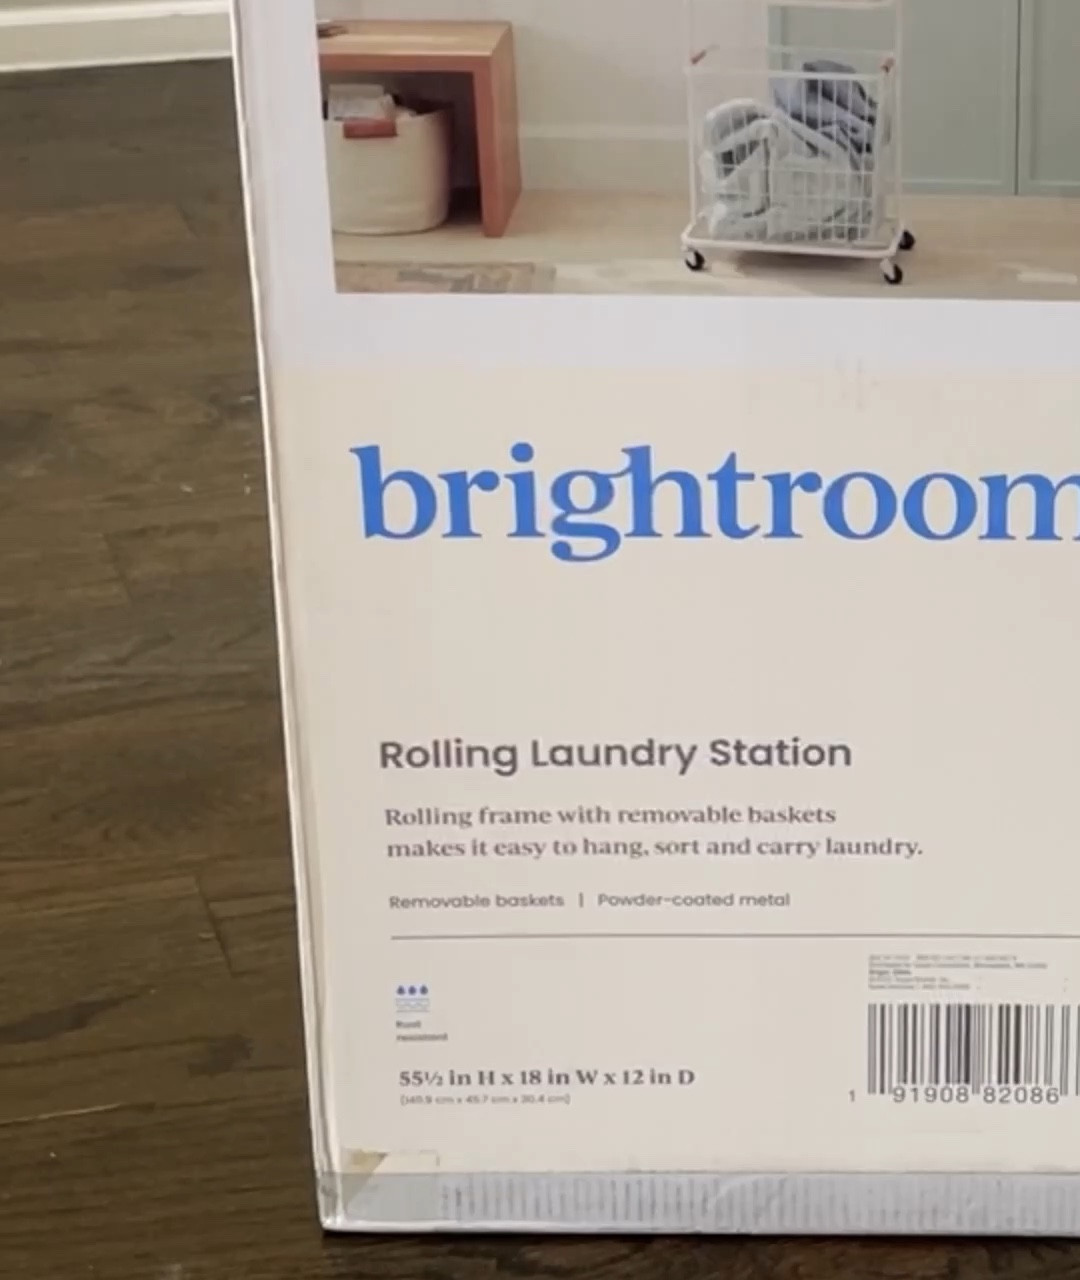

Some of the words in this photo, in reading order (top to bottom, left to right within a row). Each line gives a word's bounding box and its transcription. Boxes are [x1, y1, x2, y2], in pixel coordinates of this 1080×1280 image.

[379, 736, 519, 778] Rolling
[530, 737, 699, 777] Laundry
[708, 735, 852, 768] Station
[384, 806, 473, 830] Rolling
[478, 805, 553, 825] frame
[556, 805, 611, 825] with
[617, 805, 742, 824] removable
[747, 805, 837, 824] baskets
[387, 839, 466, 858] makes
[471, 838, 488, 857] it
[492, 841, 547, 860] easy
[552, 839, 578, 856] to
[582, 837, 650, 860] hang,
[653, 839, 700, 856] sort
[706, 837, 751, 856] and
[756, 841, 821, 859] carry
[825, 836, 923, 859] laundry.
[388, 893, 491, 910] Removable
[495, 892, 565, 909] baskets
[597, 892, 734, 908] Powder-coated
[738, 892, 791, 908] metal
[449, 1069, 472, 1086] in
[477, 1070, 495, 1086] H
[501, 1073, 514, 1086] x
[520, 1070, 542, 1086] 18
[547, 1068, 571, 1086] in
[575, 1069, 599, 1085] W
[603, 1072, 616, 1085] x
[622, 1069, 645, 1085] 12
[649, 1068, 672, 1085] in
[678, 1069, 696, 1085] D
[849, 1090, 856, 1102] 1
[892, 1086, 970, 1103] 91908
[982, 1086, 1060, 1104] 82086
